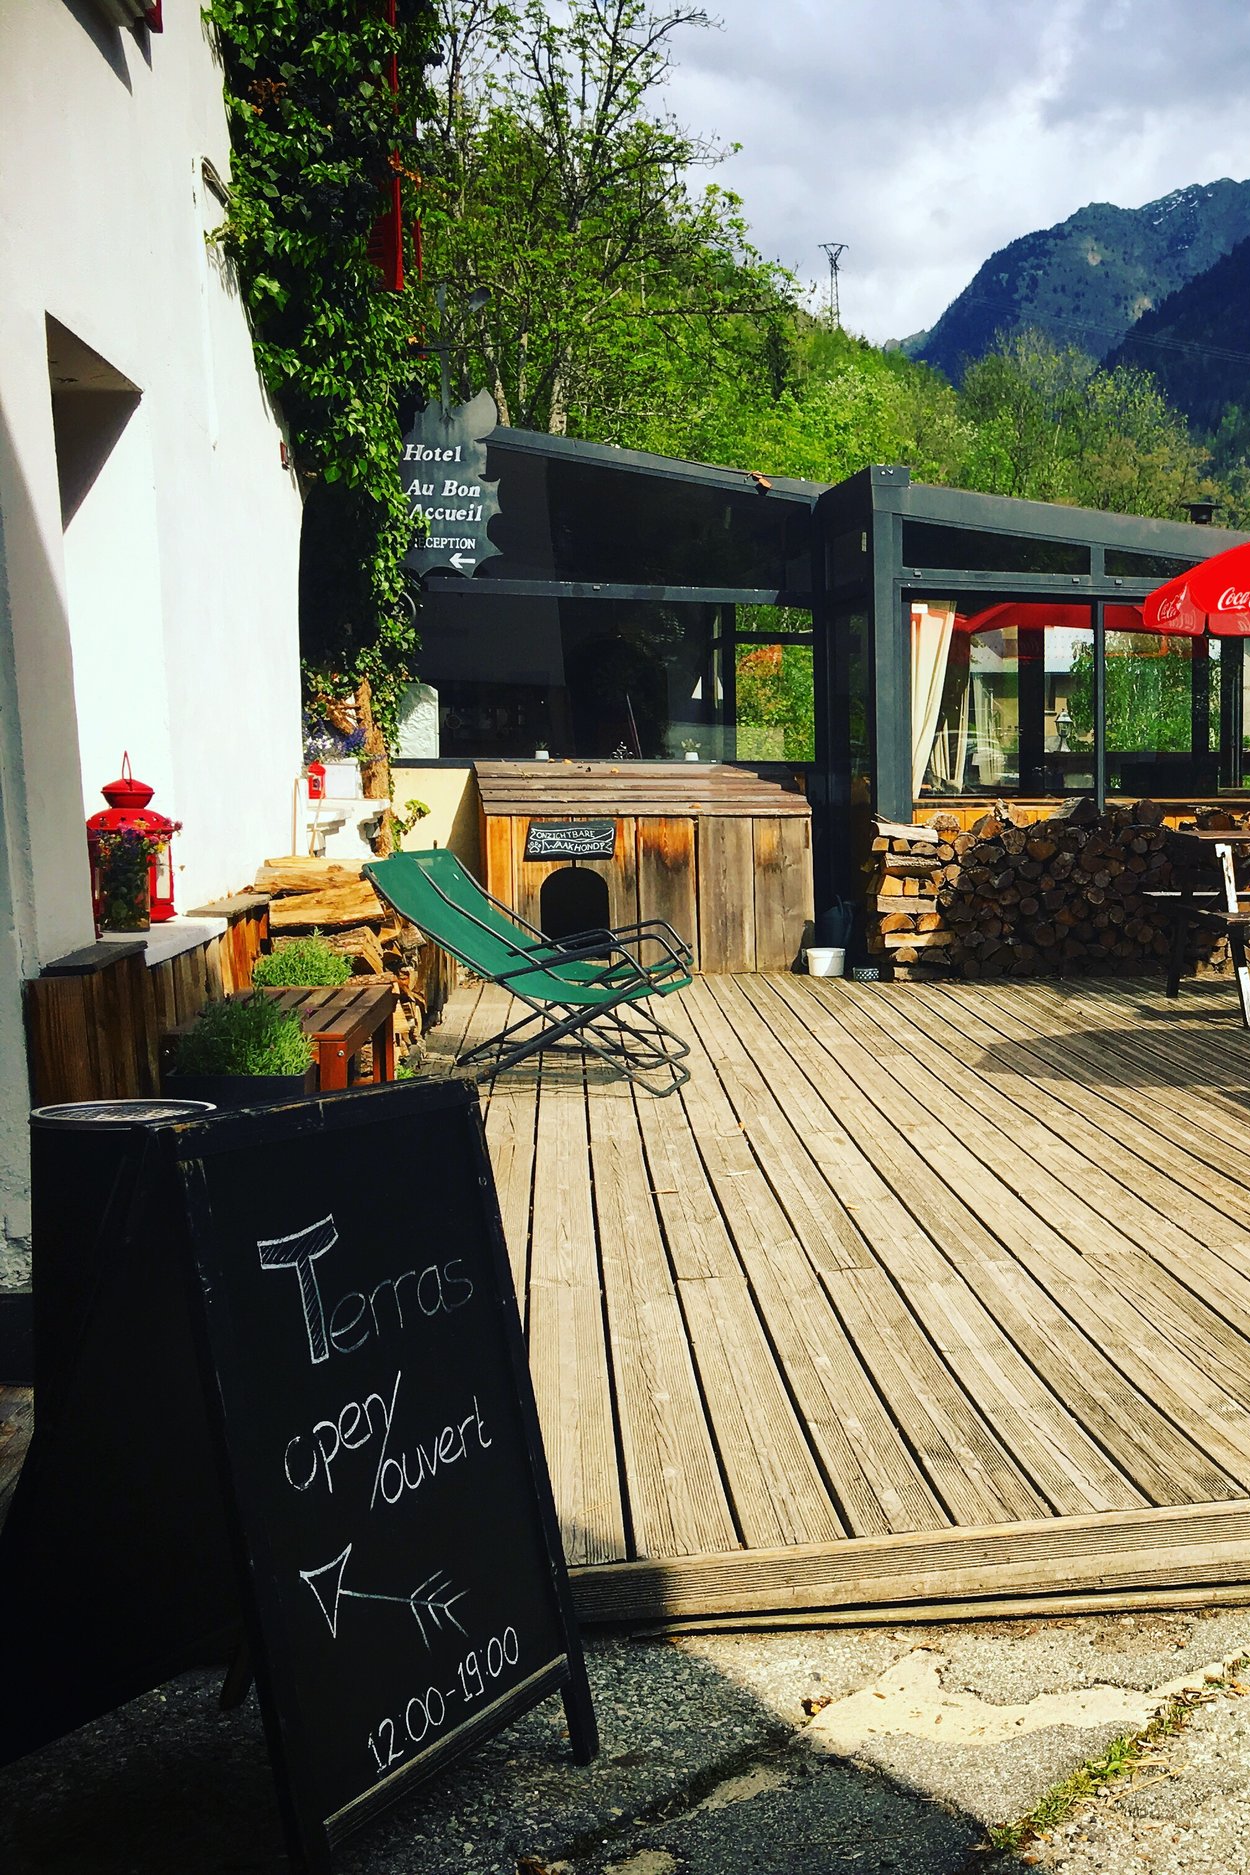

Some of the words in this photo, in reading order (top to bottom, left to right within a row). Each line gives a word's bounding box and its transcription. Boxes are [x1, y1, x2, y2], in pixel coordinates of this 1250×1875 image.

[403, 443, 463, 463] Hotel
[405, 479, 434, 496] Au
[441, 480, 481, 498] Bon
[409, 503, 484, 522] Accueil
[256, 1213, 474, 1365] Terras
